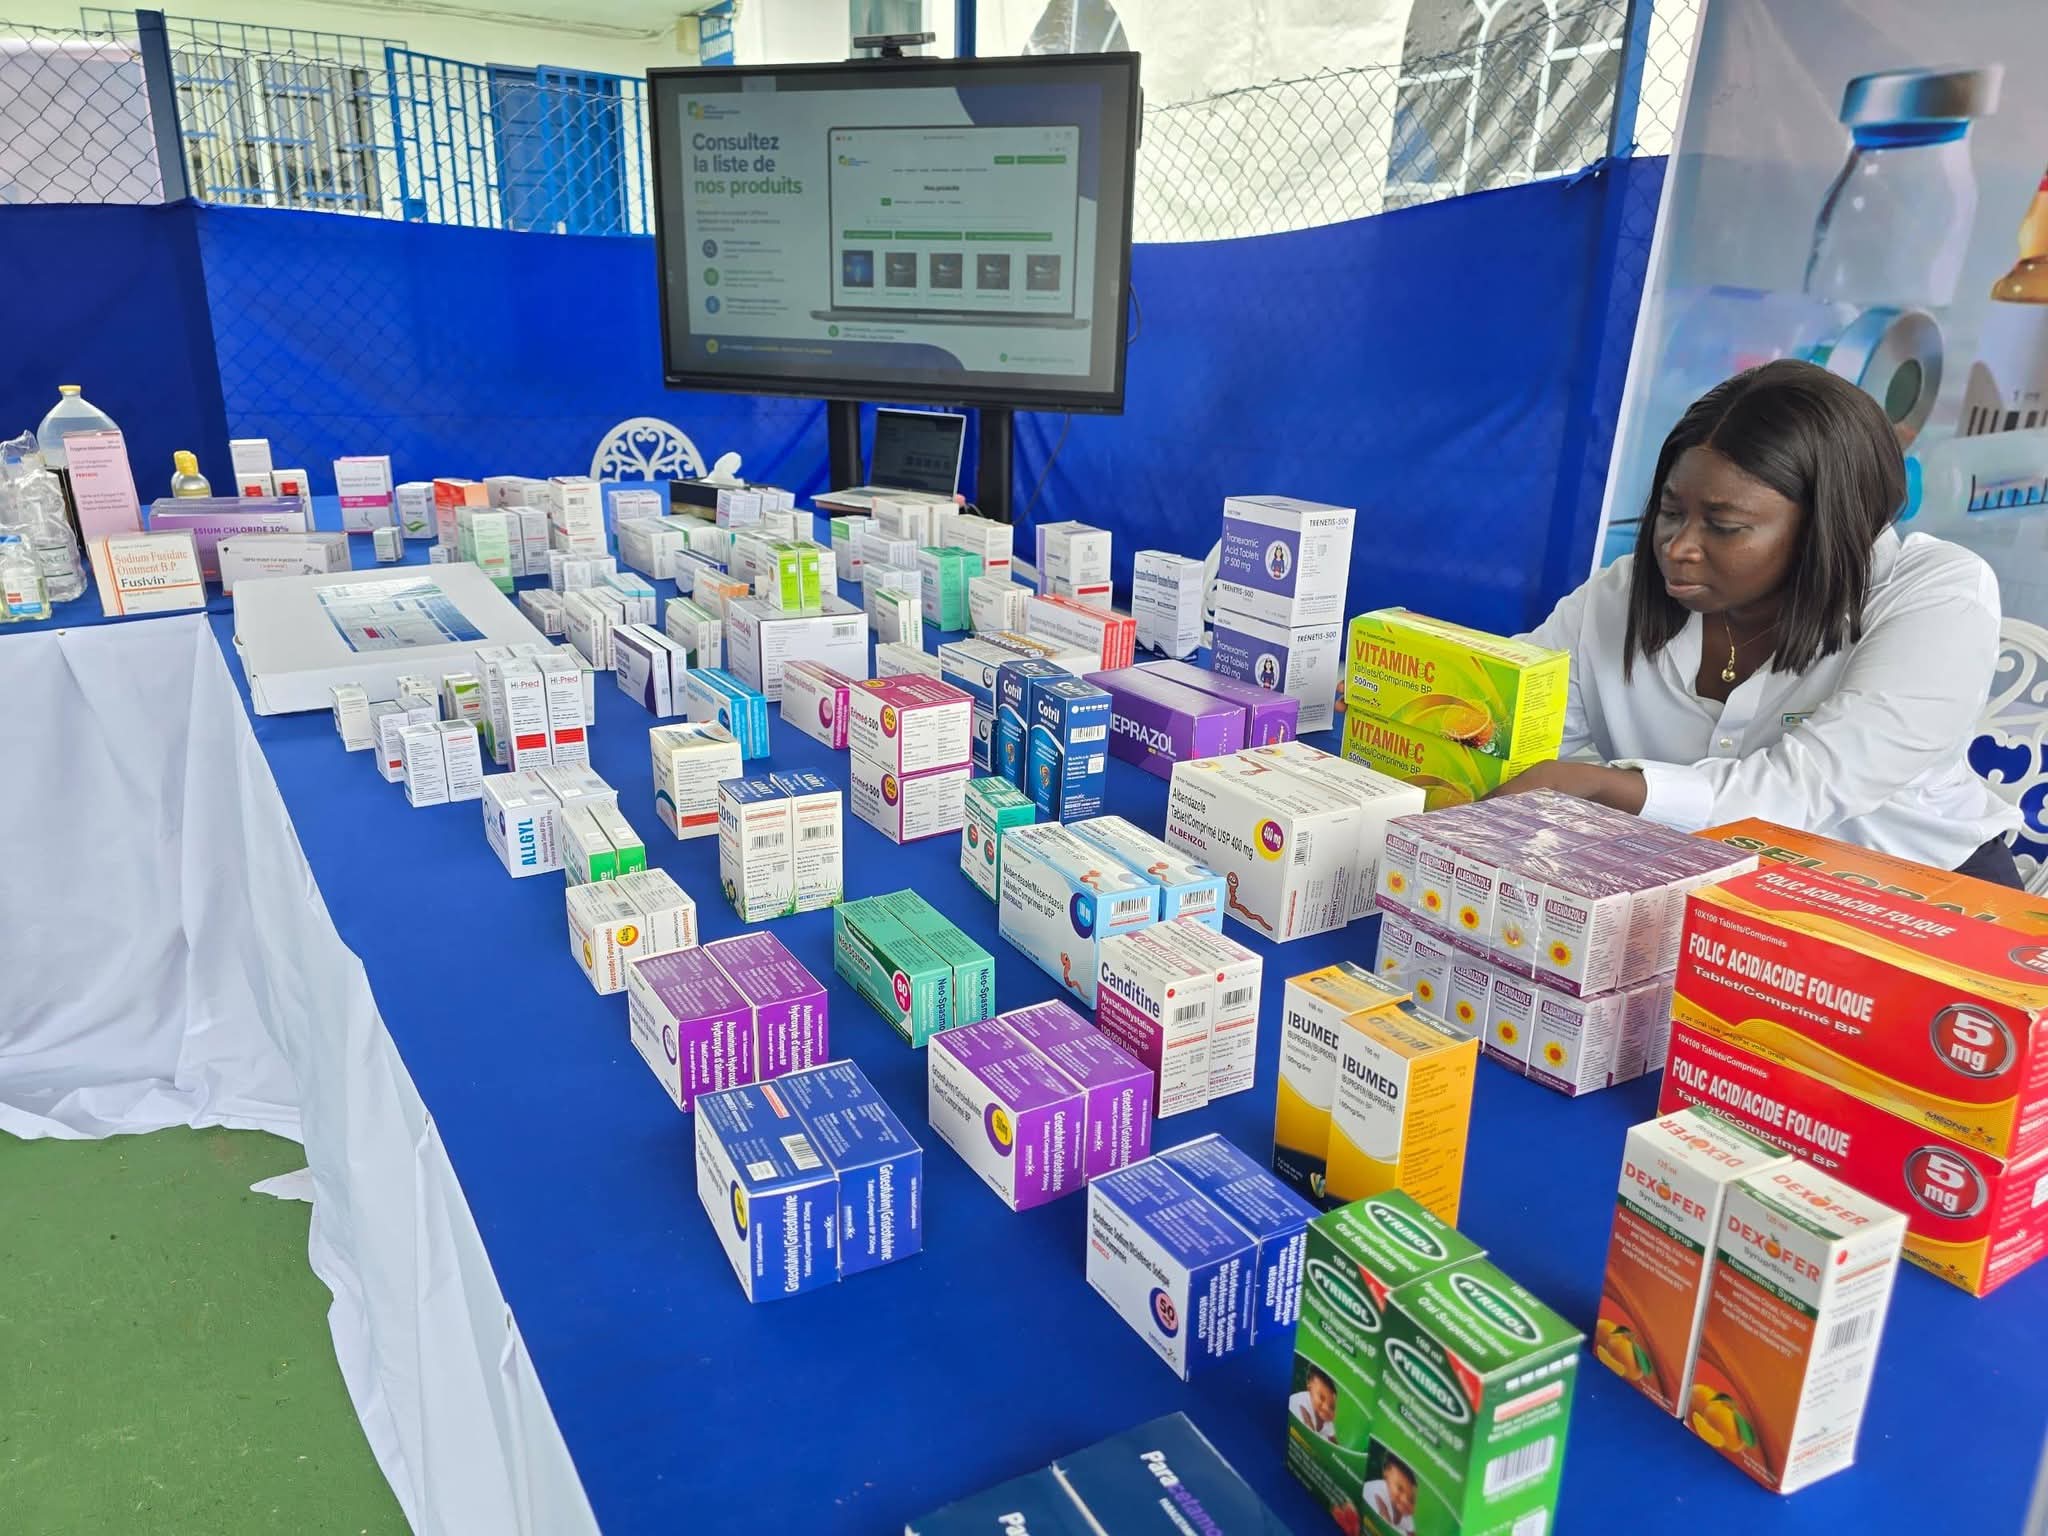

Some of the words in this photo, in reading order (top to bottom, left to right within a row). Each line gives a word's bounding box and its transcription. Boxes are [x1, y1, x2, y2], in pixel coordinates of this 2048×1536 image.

[692, 132, 779, 150] Consultez
[694, 155, 708, 172] la
[713, 153, 748, 172] liste
[753, 154, 776, 172] de
[695, 180, 725, 193] nos
[730, 176, 803, 198] produits
[223, 526, 267, 535] CHLORIDE
[1226, 532, 1259, 548] Tranexamic
[114, 552, 149, 565] Sodium
[1224, 545, 1239, 556] Acid
[1240, 547, 1259, 561] Tablets
[1230, 557, 1241, 568] 500
[117, 563, 159, 576] Ointment
[121, 576, 165, 589] Fusivin
[1215, 651, 1229, 663] Acid
[1230, 655, 1249, 671] Tablets
[1217, 640, 1249, 659] Tranexamic
[1355, 639, 1420, 679] VITAMIN
[1424, 661, 1436, 684] C
[550, 675, 578, 684] Hi-Pred
[1221, 664, 1231, 676] 500
[1353, 662, 1420, 692] Tablets/Comprimés
[1420, 684, 1433, 695] BP
[511, 680, 540, 689] Hi-Pred
[1003, 679, 1023, 701] Cotril
[1353, 675, 1378, 692] 500mg
[1037, 700, 1060, 725] Cotril
[1111, 713, 1177, 756] EPRAZOL
[1351, 716, 1410, 759] VITAMIN
[1414, 742, 1425, 764] C
[1348, 752, 1371, 769] 500mg
[1410, 764, 1421, 775] BP
[1172, 787, 1206, 814] Albendazole
[518, 817, 536, 865] ALLGYL
[1169, 824, 1207, 850] ALBENZOL
[1217, 829, 1231, 845] USP
[1231, 834, 1243, 852] 400
[1243, 844, 1254, 861] mg
[1263, 826, 1274, 842] 400
[1273, 835, 1282, 849] mg
[1456, 867, 1491, 890] ALBENDAZOLE
[1545, 899, 1587, 924] ALBENDAZOLE
[1757, 873, 1804, 893] FOLIC
[1803, 882, 1884, 920] ACID/ACIDE
[1879, 907, 1958, 939] FOLIQUE
[1694, 908, 1718, 923] 10X100
[1718, 917, 1788, 948] Tablets/Comprimés
[897, 979, 908, 997] 80
[1101, 961, 1160, 1019] Canditine
[1688, 932, 1727, 966] FOLIC
[1726, 948, 1806, 996] ACID/ACIDE
[1806, 977, 1875, 1023] FOLIQUE
[1495, 980, 1532, 1006] ALBENDAZOLE
[1692, 964, 1832, 1026] Tablet/Comprimé
[1833, 1020, 1865, 1036] BP
[1101, 990, 1155, 1035] Nystatin/Nystatine
[1541, 1000, 1582, 1026] ALBENDAZOLE
[1138, 1027, 1147, 1039] BP
[1952, 1011, 1994, 1047] 5
[1677, 1033, 1700, 1050] 10X100
[1700, 1043, 1768, 1079] Tablets/Comprimés
[1950, 1043, 1987, 1072] mg
[1342, 1053, 1399, 1100] IBUMED
[1672, 1056, 1708, 1092] FOLIC
[1708, 1075, 1784, 1127] ACID/ACIDE
[1785, 1108, 1852, 1157] FOLIQUE
[1675, 1087, 1809, 1156] Tablet/Comprimé
[1811, 1152, 1839, 1169] BP
[1925, 1153, 1966, 1189] 5
[1638, 1189, 1685, 1223] Syrup/Sirop
[1923, 1182, 1960, 1213] mg
[1373, 1207, 1435, 1255] PYRIMOL
[1422, 1210, 1434, 1224] 100
[1434, 1219, 1447, 1231] ml
[1625, 1200, 1668, 1234] Haematinic
[1668, 1227, 1695, 1249] Syrup
[1335, 1222, 1352, 1237] Oral
[1351, 1234, 1398, 1273] Suspension
[1332, 1254, 1346, 1269] 100
[1345, 1266, 1358, 1280] ml
[1744, 1246, 1796, 1284] Syrup/Sirop
[1313, 1267, 1371, 1324] PYRIMOL
[1510, 1285, 1526, 1300] 100
[1526, 1297, 1539, 1307] ml
[1727, 1256, 1776, 1294] Haematinic
[1777, 1286, 1807, 1311] Syrup
[1159, 1298, 1175, 1322] 50
[1458, 1280, 1527, 1337] PYRIMOL
[1417, 1296, 1436, 1314] Oral
[1435, 1310, 1488, 1357] Suspension
[1415, 1335, 1431, 1352] 100
[1431, 1350, 1443, 1364] ml
[1393, 1348, 1458, 1414] PYRIMOL
